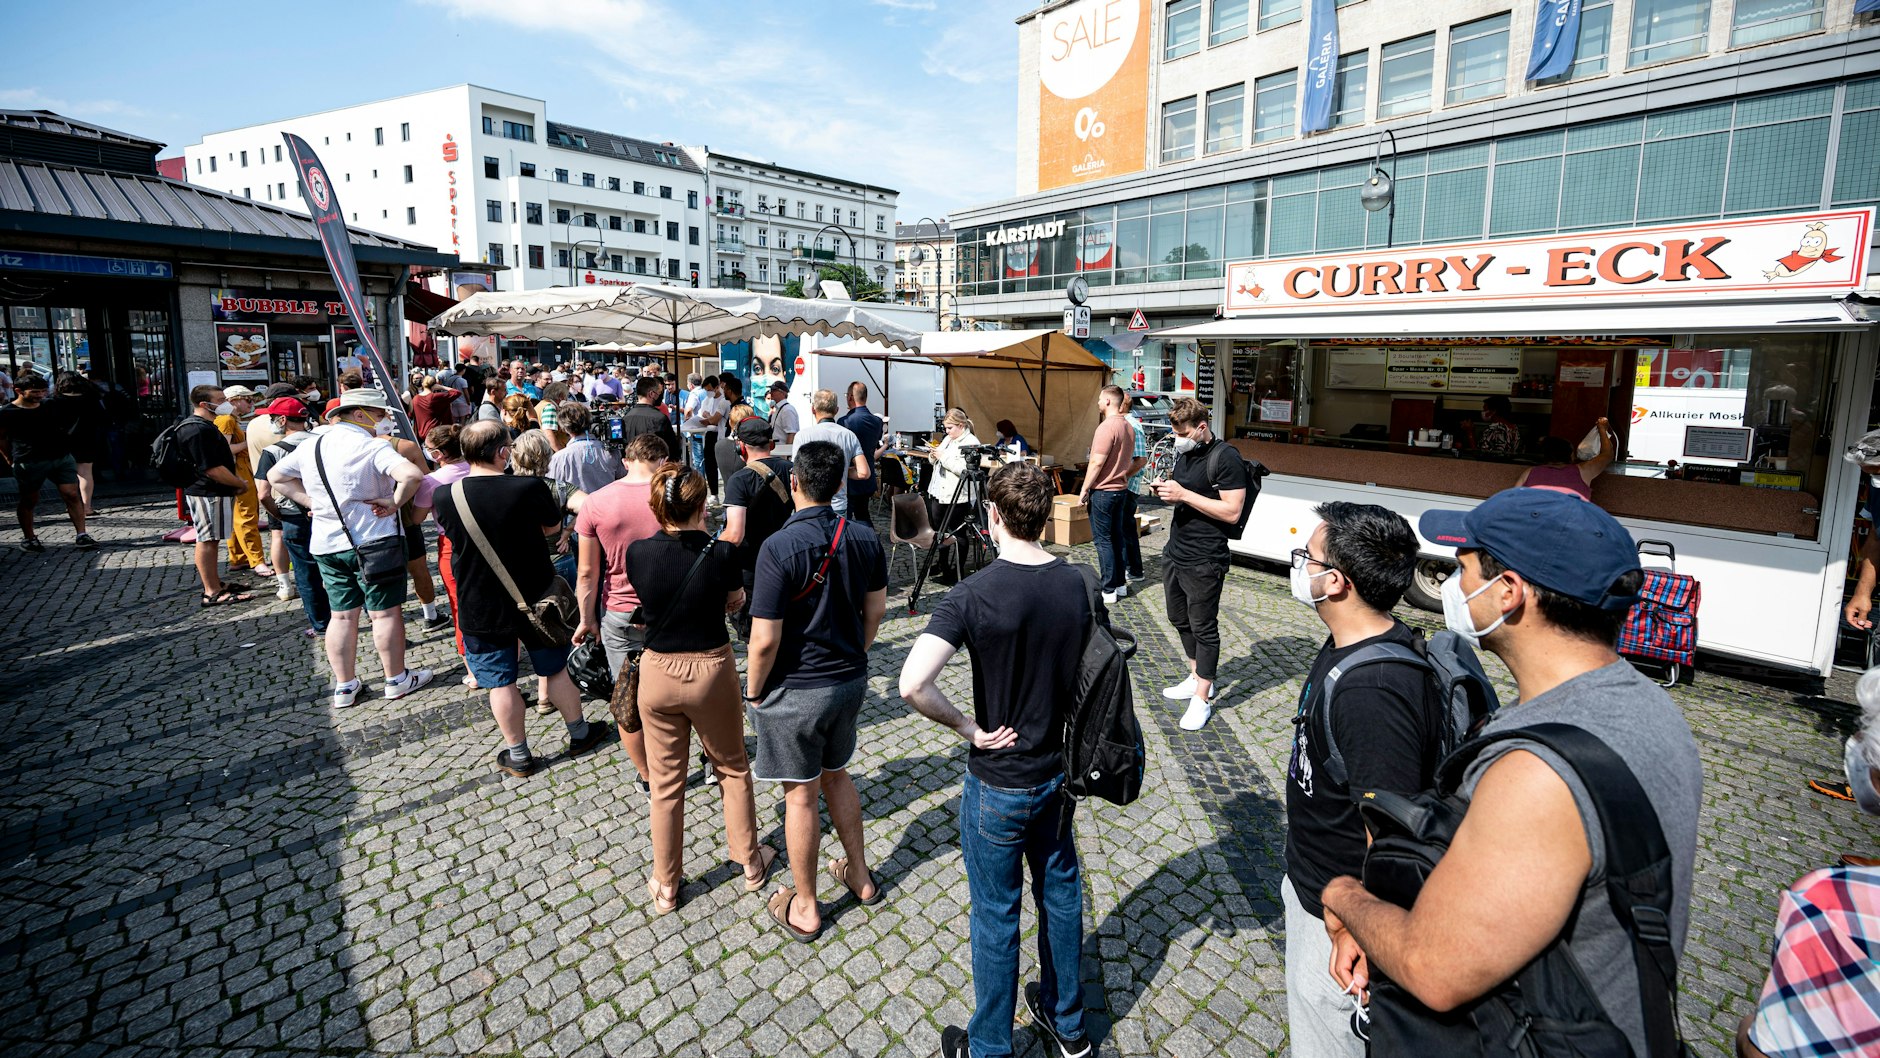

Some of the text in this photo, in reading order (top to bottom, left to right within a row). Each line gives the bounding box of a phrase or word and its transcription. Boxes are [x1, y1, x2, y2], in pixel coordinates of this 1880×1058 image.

[1051, 0, 1121, 62] SALE
[1315, 31, 1333, 89] GALERIA
[1071, 159, 1106, 174] GALERIA
[986, 219, 1067, 247] KARSTADT
[1283, 236, 1732, 299] CURRY - ECK
[220, 297, 318, 315] BUBBLE
[1649, 410, 1705, 420] Allkurier
